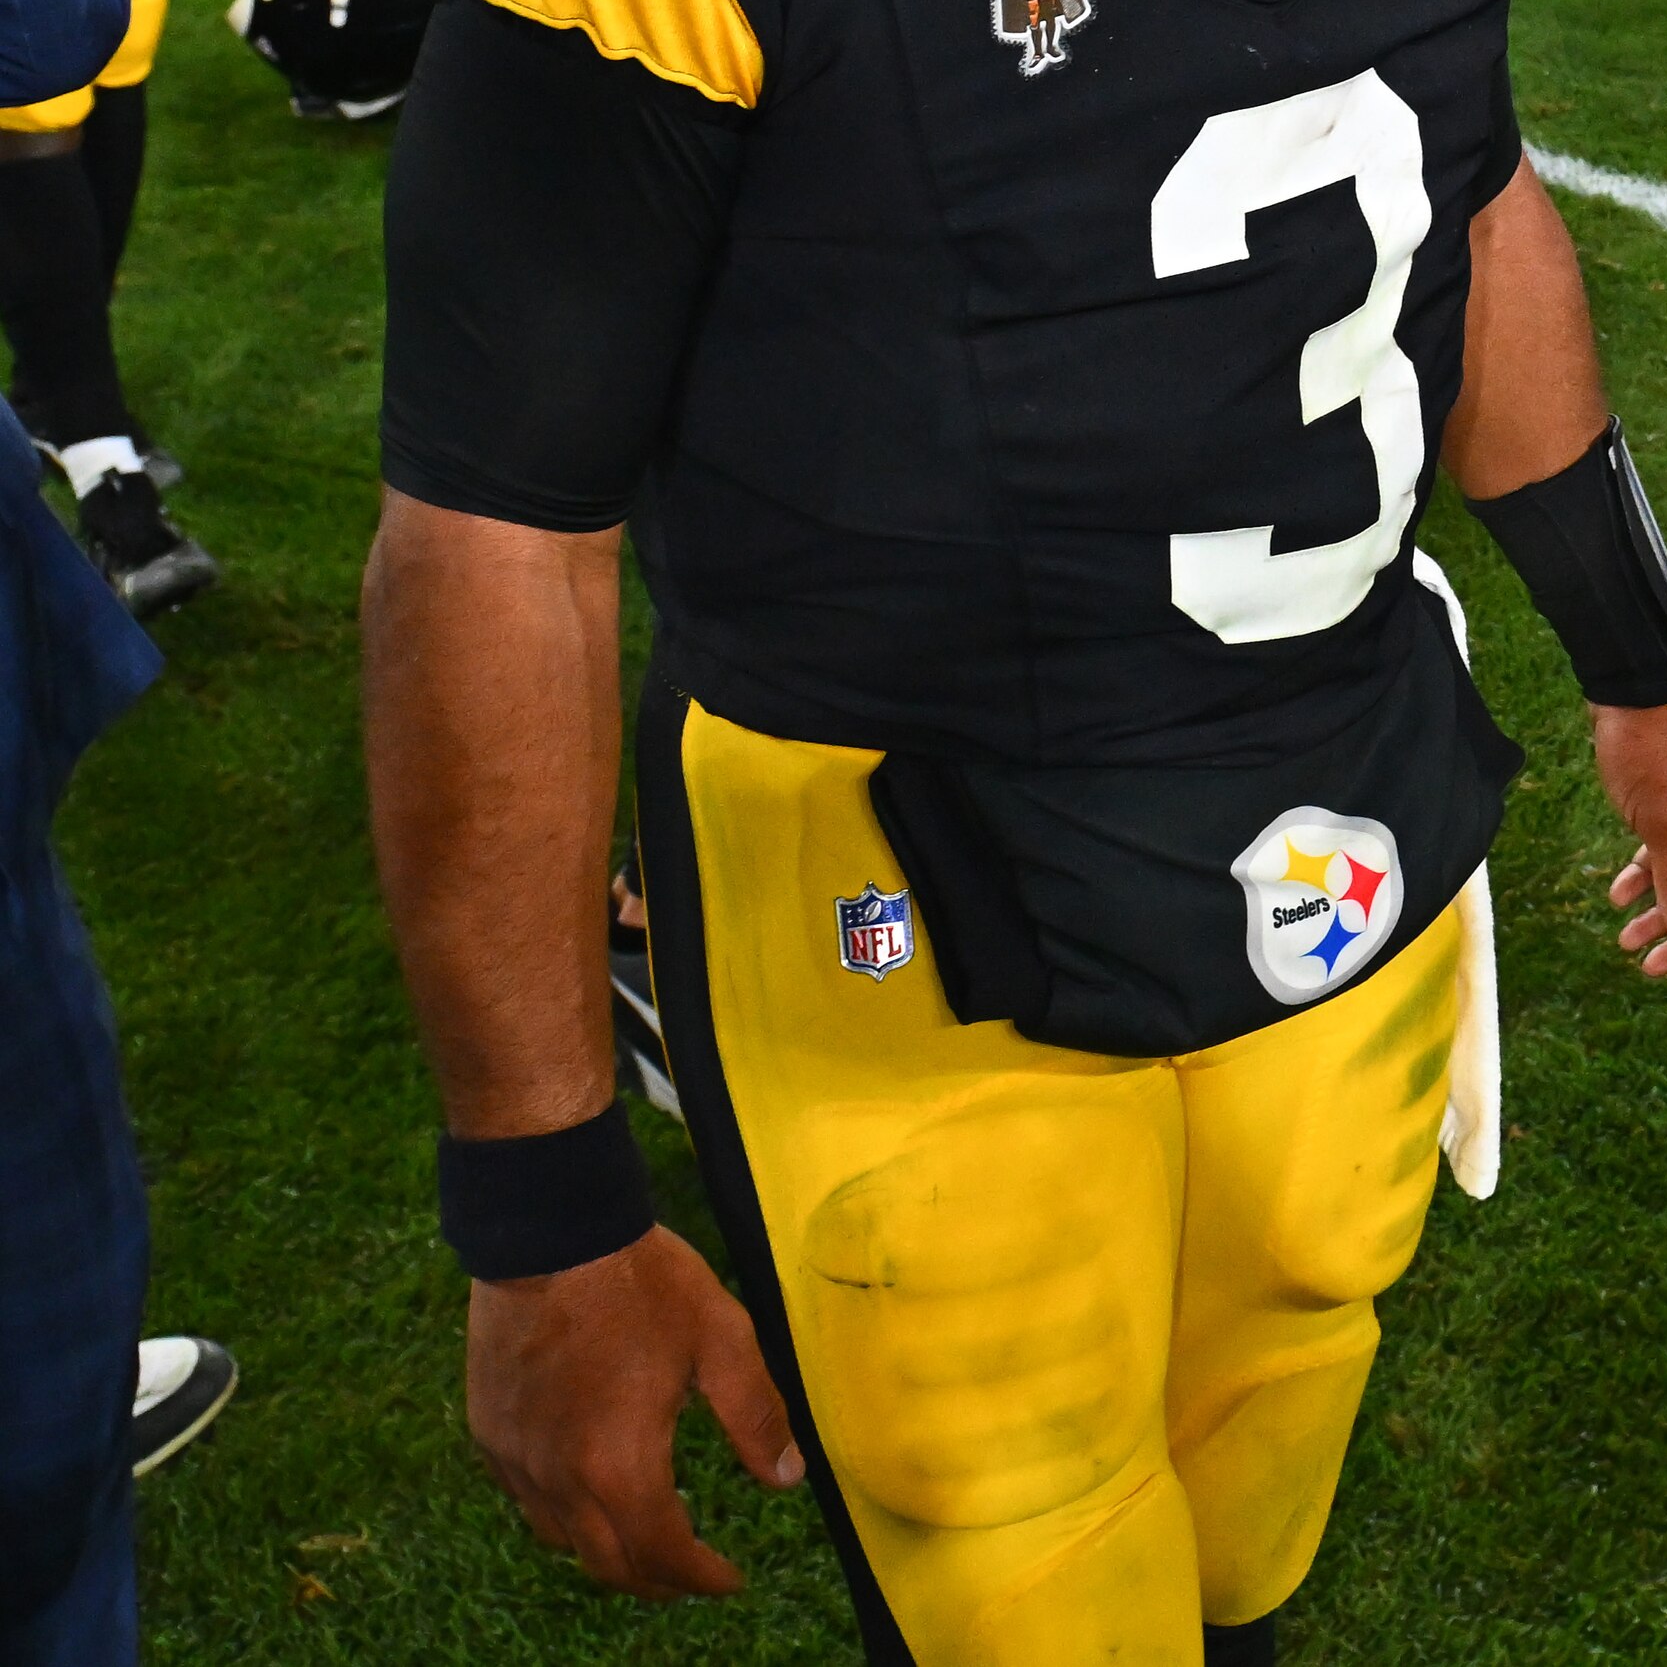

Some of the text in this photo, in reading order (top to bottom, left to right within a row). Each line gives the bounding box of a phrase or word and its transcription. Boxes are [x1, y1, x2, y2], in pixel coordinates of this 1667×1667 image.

[1151, 67, 1434, 645] 3
[1272, 896, 1331, 929] Steelers
[850, 925, 902, 964] NFL
